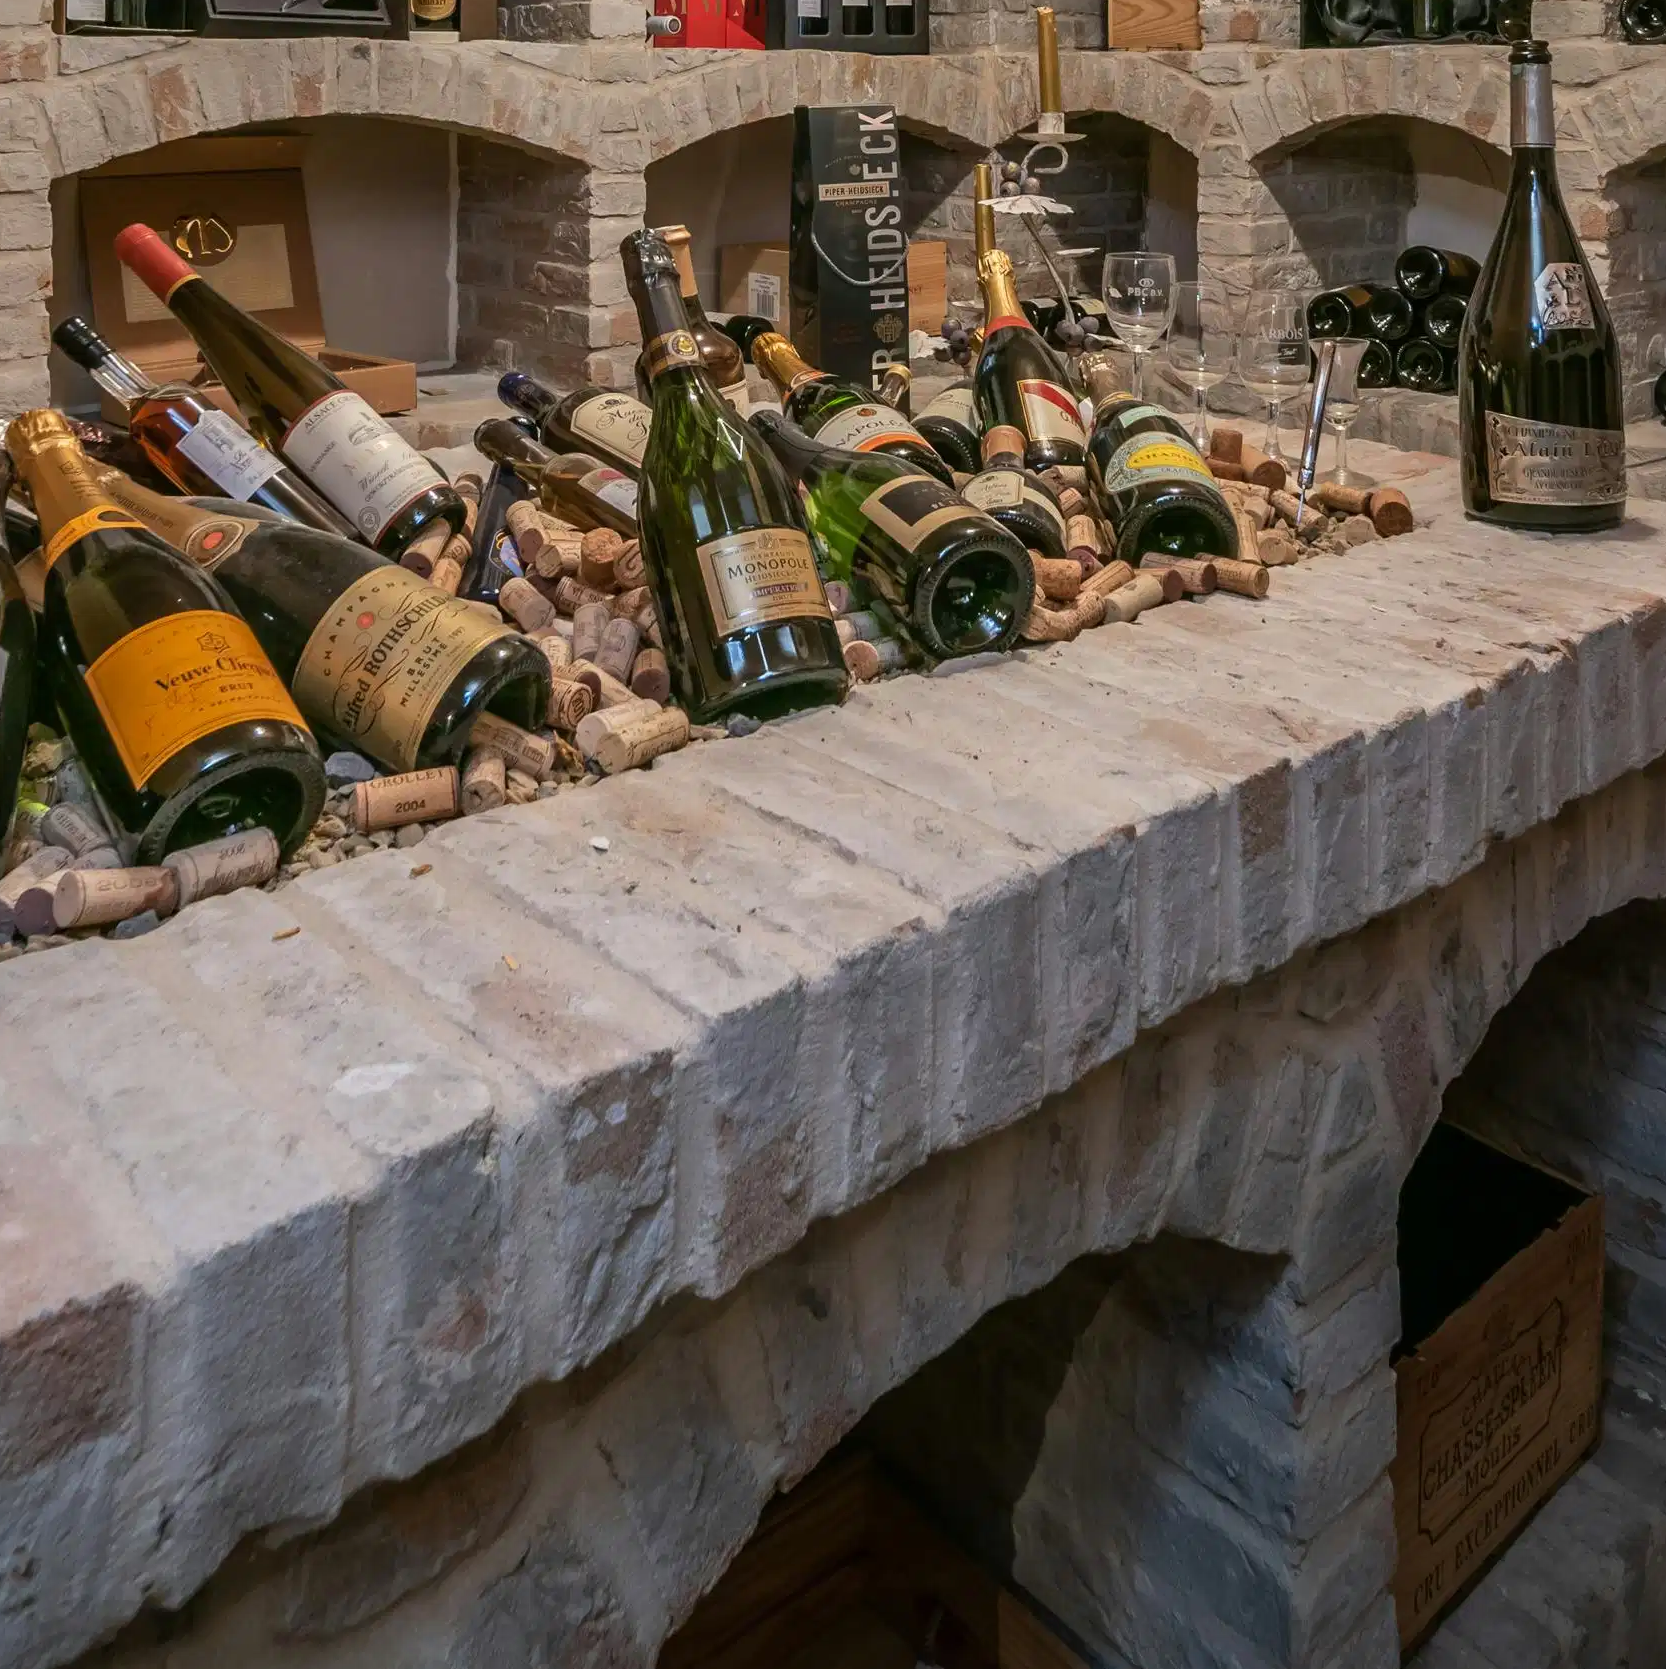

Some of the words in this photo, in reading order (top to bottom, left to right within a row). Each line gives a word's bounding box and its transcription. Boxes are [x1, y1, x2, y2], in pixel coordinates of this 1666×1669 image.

[823, 185, 884, 199] PIPER-HEIDSIECK
[1128, 287, 1149, 297] PBC
[1510, 440, 1575, 459] Alain
[727, 557, 810, 581] MONOPOLE
[341, 676, 372, 733] Alfred
[363, 592, 451, 677] ROTHSCHILD
[407, 634, 442, 678] BRUT
[155, 665, 214, 692] Veuve
[218, 681, 254, 694] BRUT
[395, 799, 426, 813] 2004
[1420, 1345, 1562, 1503] CHASSE-SPLEEN
[1412, 1561, 1446, 1616] CRU
[1453, 1437, 1562, 1574] EXCEPTIONNEL
